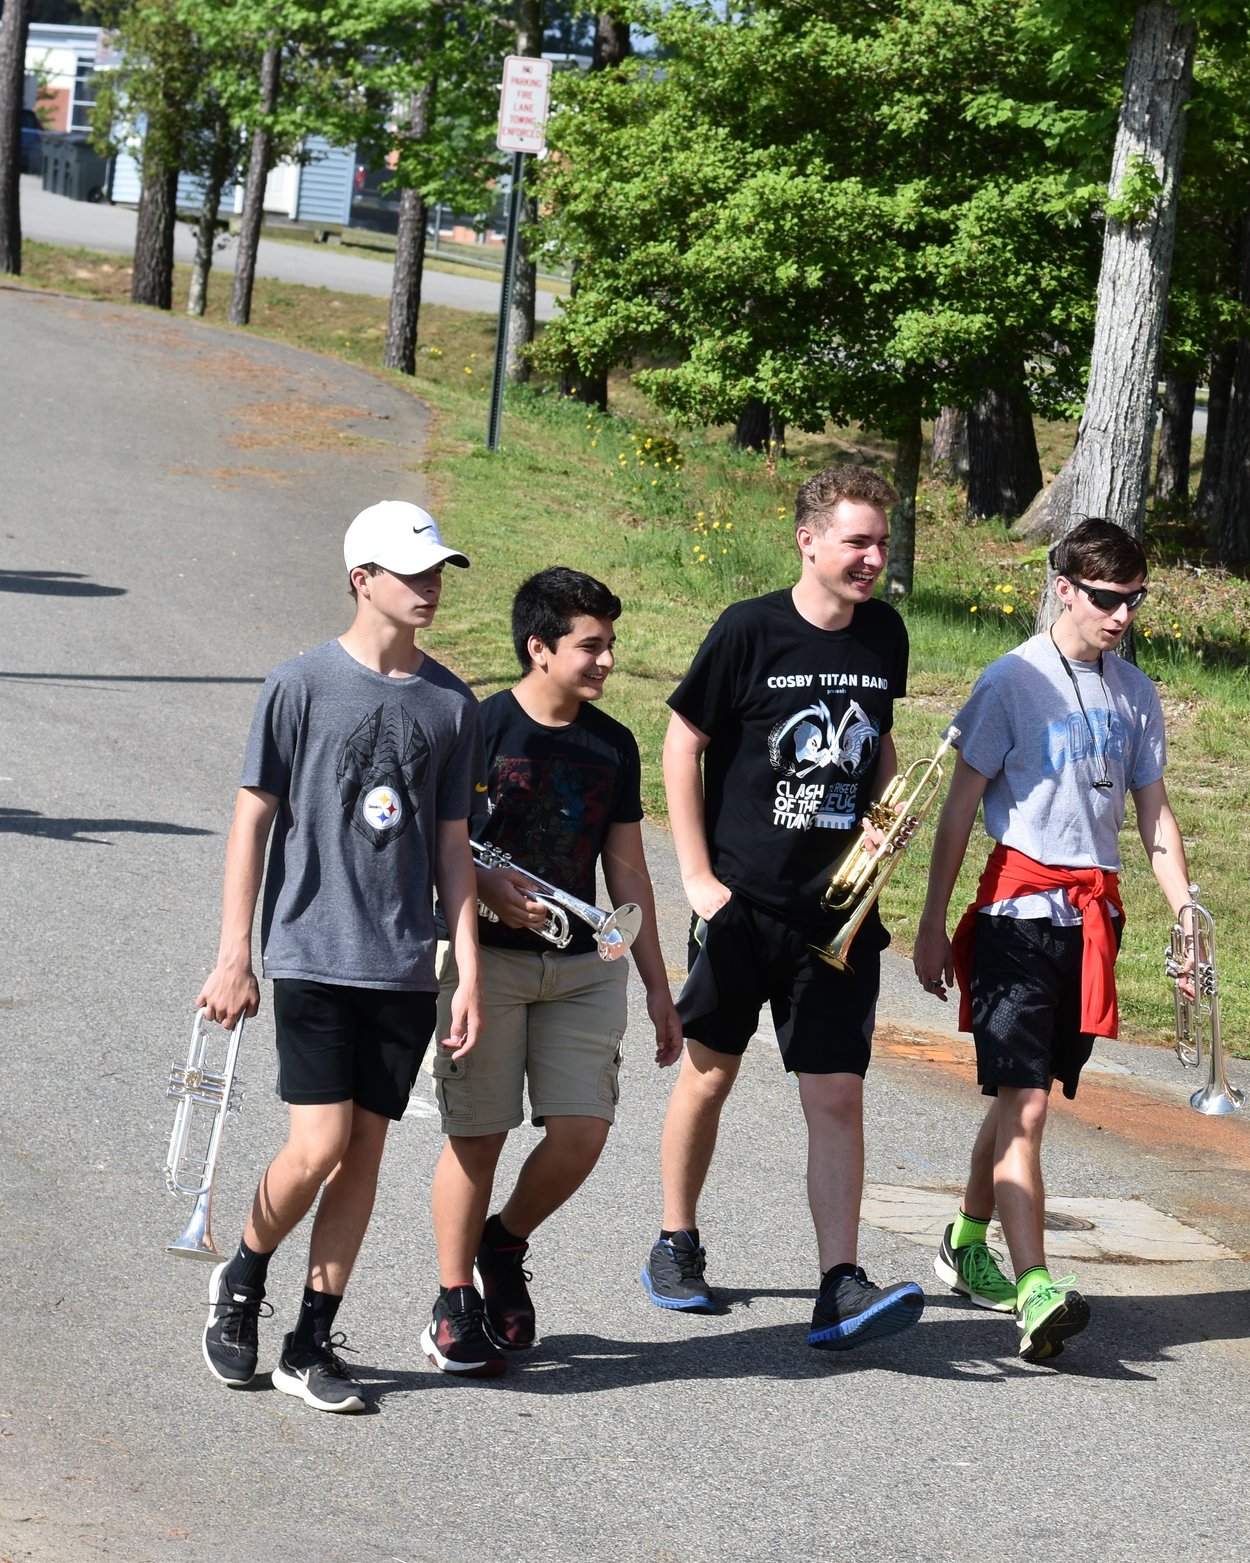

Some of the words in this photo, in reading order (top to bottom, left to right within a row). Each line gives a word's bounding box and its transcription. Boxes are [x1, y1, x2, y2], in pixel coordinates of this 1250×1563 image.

[522, 65, 533, 74] NO
[511, 76, 542, 88] PARKING
[517, 90, 533, 99] FIRE
[513, 103, 534, 112] LANE
[510, 114, 536, 126] TOWING
[501, 127, 541, 138] ENFORCED
[767, 674, 814, 689] COSBY
[818, 673, 858, 687] TITAN
[861, 674, 888, 691] BAND
[776, 780, 825, 800] CLASH
[774, 796, 797, 814] OF
[797, 799, 822, 814] THE
[772, 808, 815, 833] TITANS
